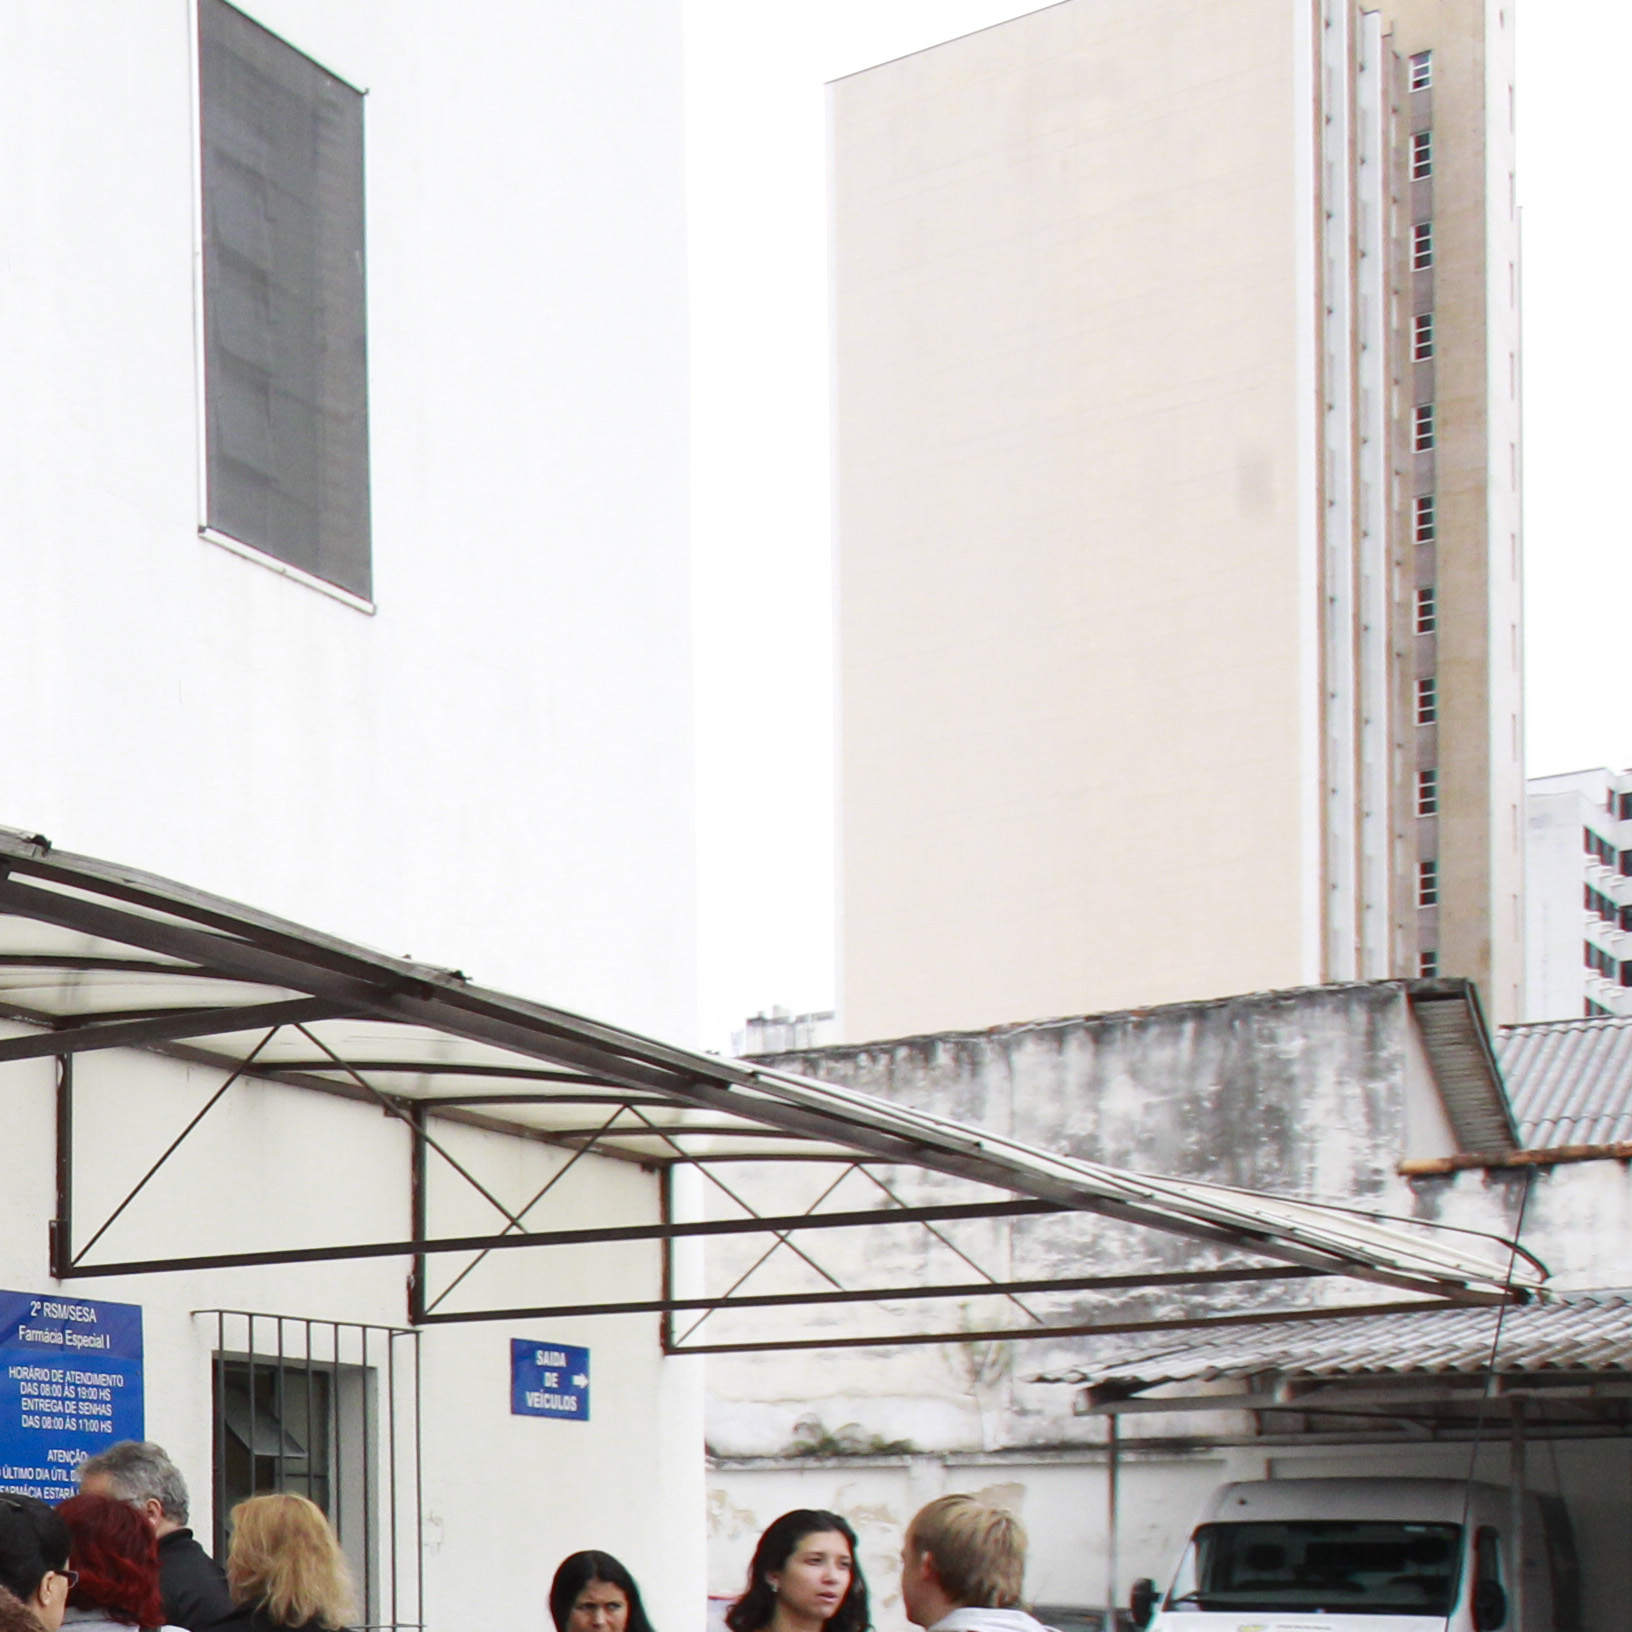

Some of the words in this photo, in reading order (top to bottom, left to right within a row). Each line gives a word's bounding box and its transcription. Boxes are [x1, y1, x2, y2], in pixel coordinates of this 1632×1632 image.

[18, 1325, 64, 1345] Farmácia
[65, 1330, 105, 1350] Especial
[8, 1365, 51, 1382] HORÁRIO
[51, 1369, 64, 1383] DE
[64, 1370, 124, 1387] ATENDIMENTO
[543, 1372, 559, 1388] DE
[19, 1381, 39, 1395] DAS
[98, 1388, 112, 1402] HS
[525, 1389, 578, 1412] VEÍCULOS
[21, 1397, 64, 1413] ENTREGA
[64, 1401, 77, 1414] DE
[77, 1401, 113, 1417] SENHAS
[21, 1414, 41, 1429] DAS
[100, 1420, 113, 1434] HS
[2, 1463, 35, 1480] ÚLTIMO
[35, 1467, 51, 1481] DIA
[50, 1465, 70, 1482] ÚTIL
